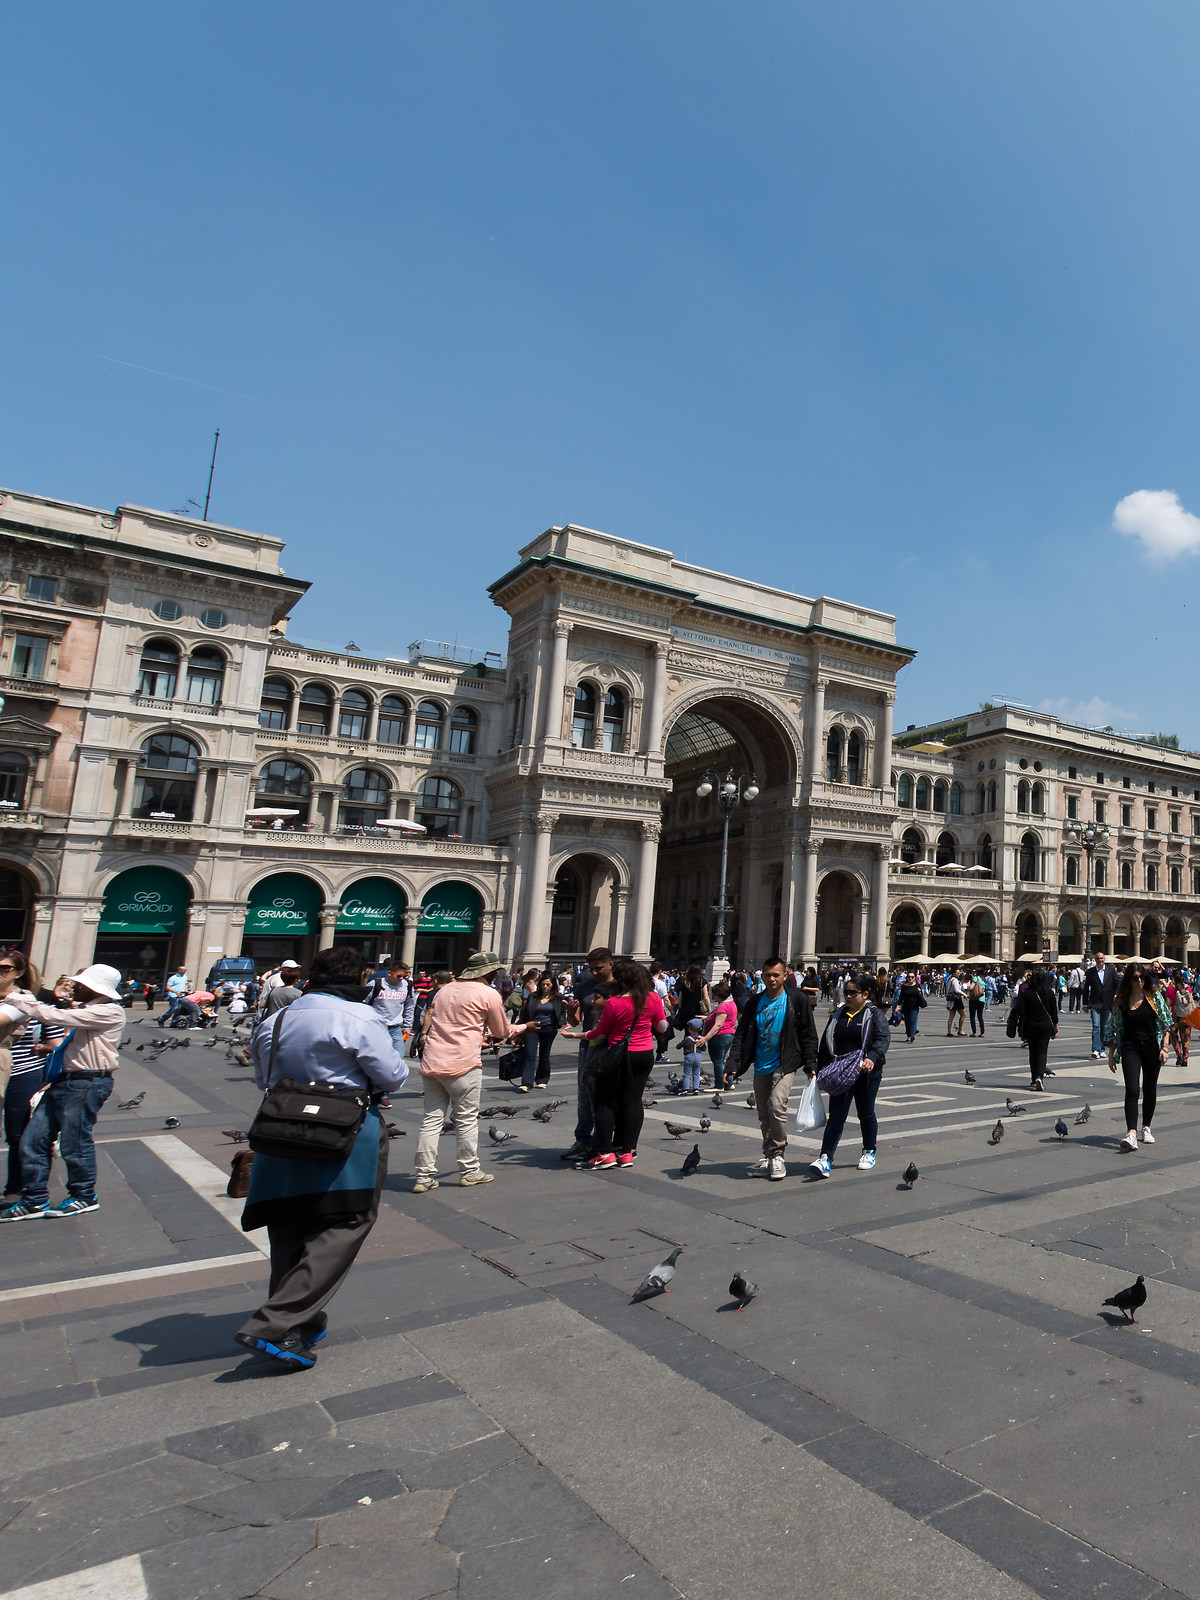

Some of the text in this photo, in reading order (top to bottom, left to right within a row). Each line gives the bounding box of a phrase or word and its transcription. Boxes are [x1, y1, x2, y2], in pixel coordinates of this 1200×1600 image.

[683, 631, 715, 643] VITTORIO
[718, 639, 755, 652] EMANUELE
[774, 652, 803, 663] MILANESI
[118, 903, 173, 913] GRIMOLDI
[342, 899, 395, 917] Currado
[423, 902, 472, 920] Currado
[554, 900, 574, 911] ARI
[257, 909, 308, 919] GRIMOLDI
[378, 989, 407, 1001] CLEMSO
